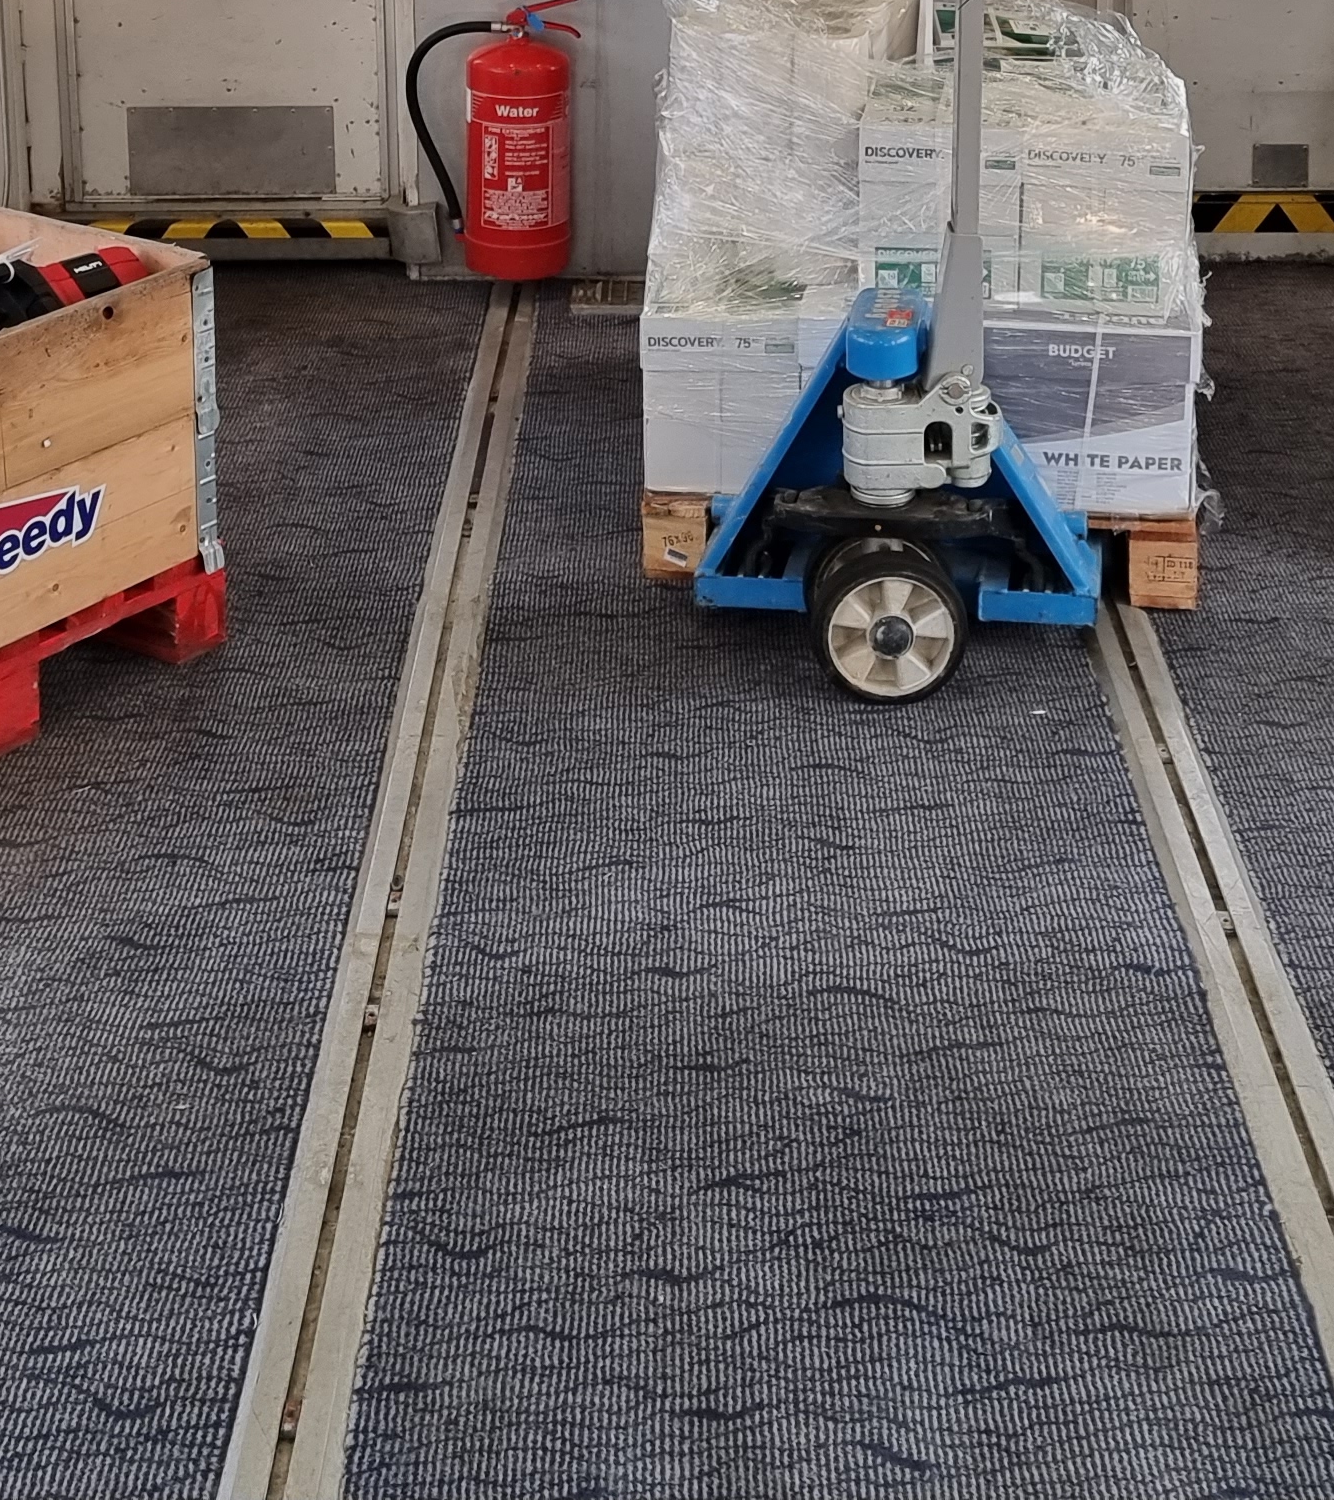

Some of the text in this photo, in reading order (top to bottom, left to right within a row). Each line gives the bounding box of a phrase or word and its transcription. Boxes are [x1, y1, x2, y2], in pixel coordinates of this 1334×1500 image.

[495, 104, 539, 118] Water
[1048, 343, 1117, 360] BUDGET
[1043, 451, 1183, 471] WHTE PAPER
